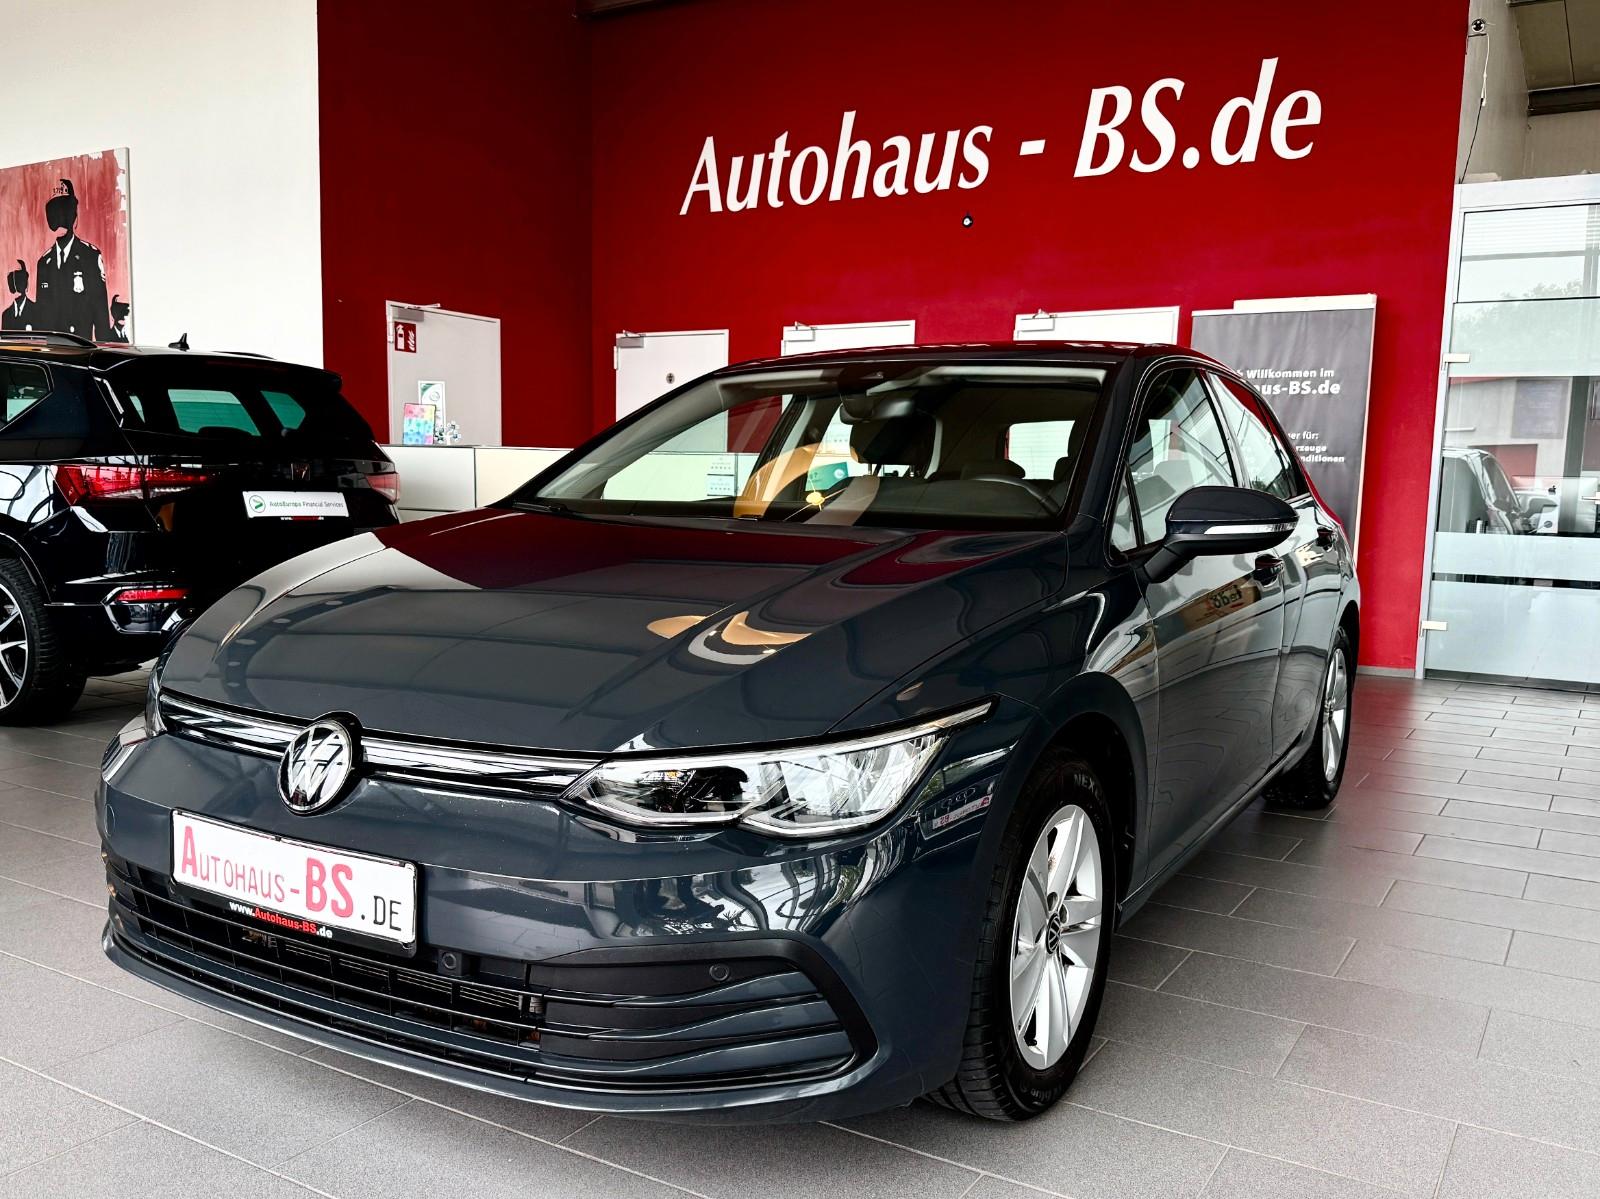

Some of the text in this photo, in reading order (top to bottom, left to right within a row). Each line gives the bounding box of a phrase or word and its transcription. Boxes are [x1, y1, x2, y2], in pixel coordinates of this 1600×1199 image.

[679, 110, 993, 216] Autohaus
[1073, 56, 1322, 178] BS.de
[1246, 368, 1317, 379] Willkommen
[229, 901, 333, 938] www.Autohaus-BS.de
